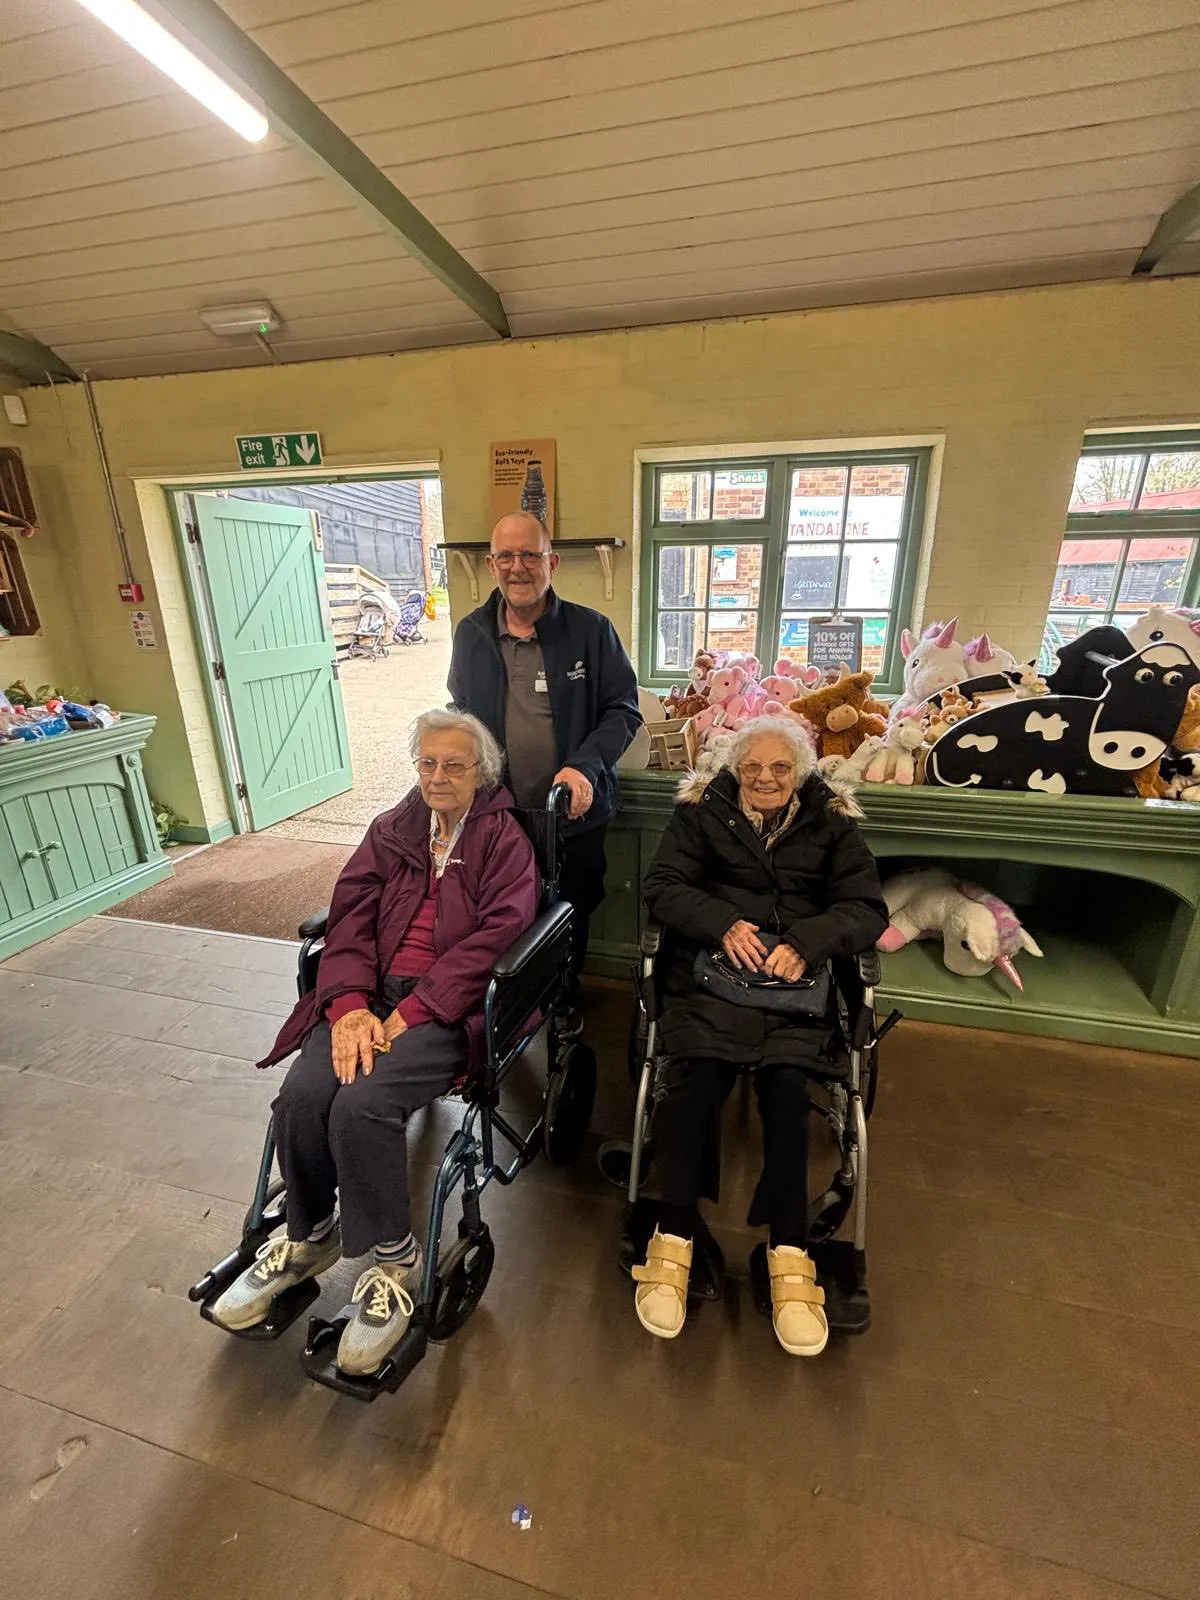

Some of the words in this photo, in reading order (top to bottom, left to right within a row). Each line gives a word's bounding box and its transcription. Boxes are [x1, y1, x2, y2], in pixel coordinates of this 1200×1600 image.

[240, 440, 263, 452] Fire
[245, 453, 266, 465] exit
[730, 471, 766, 485] Snack
[799, 508, 839, 517] Welcome
[814, 631, 838, 642] 10%
